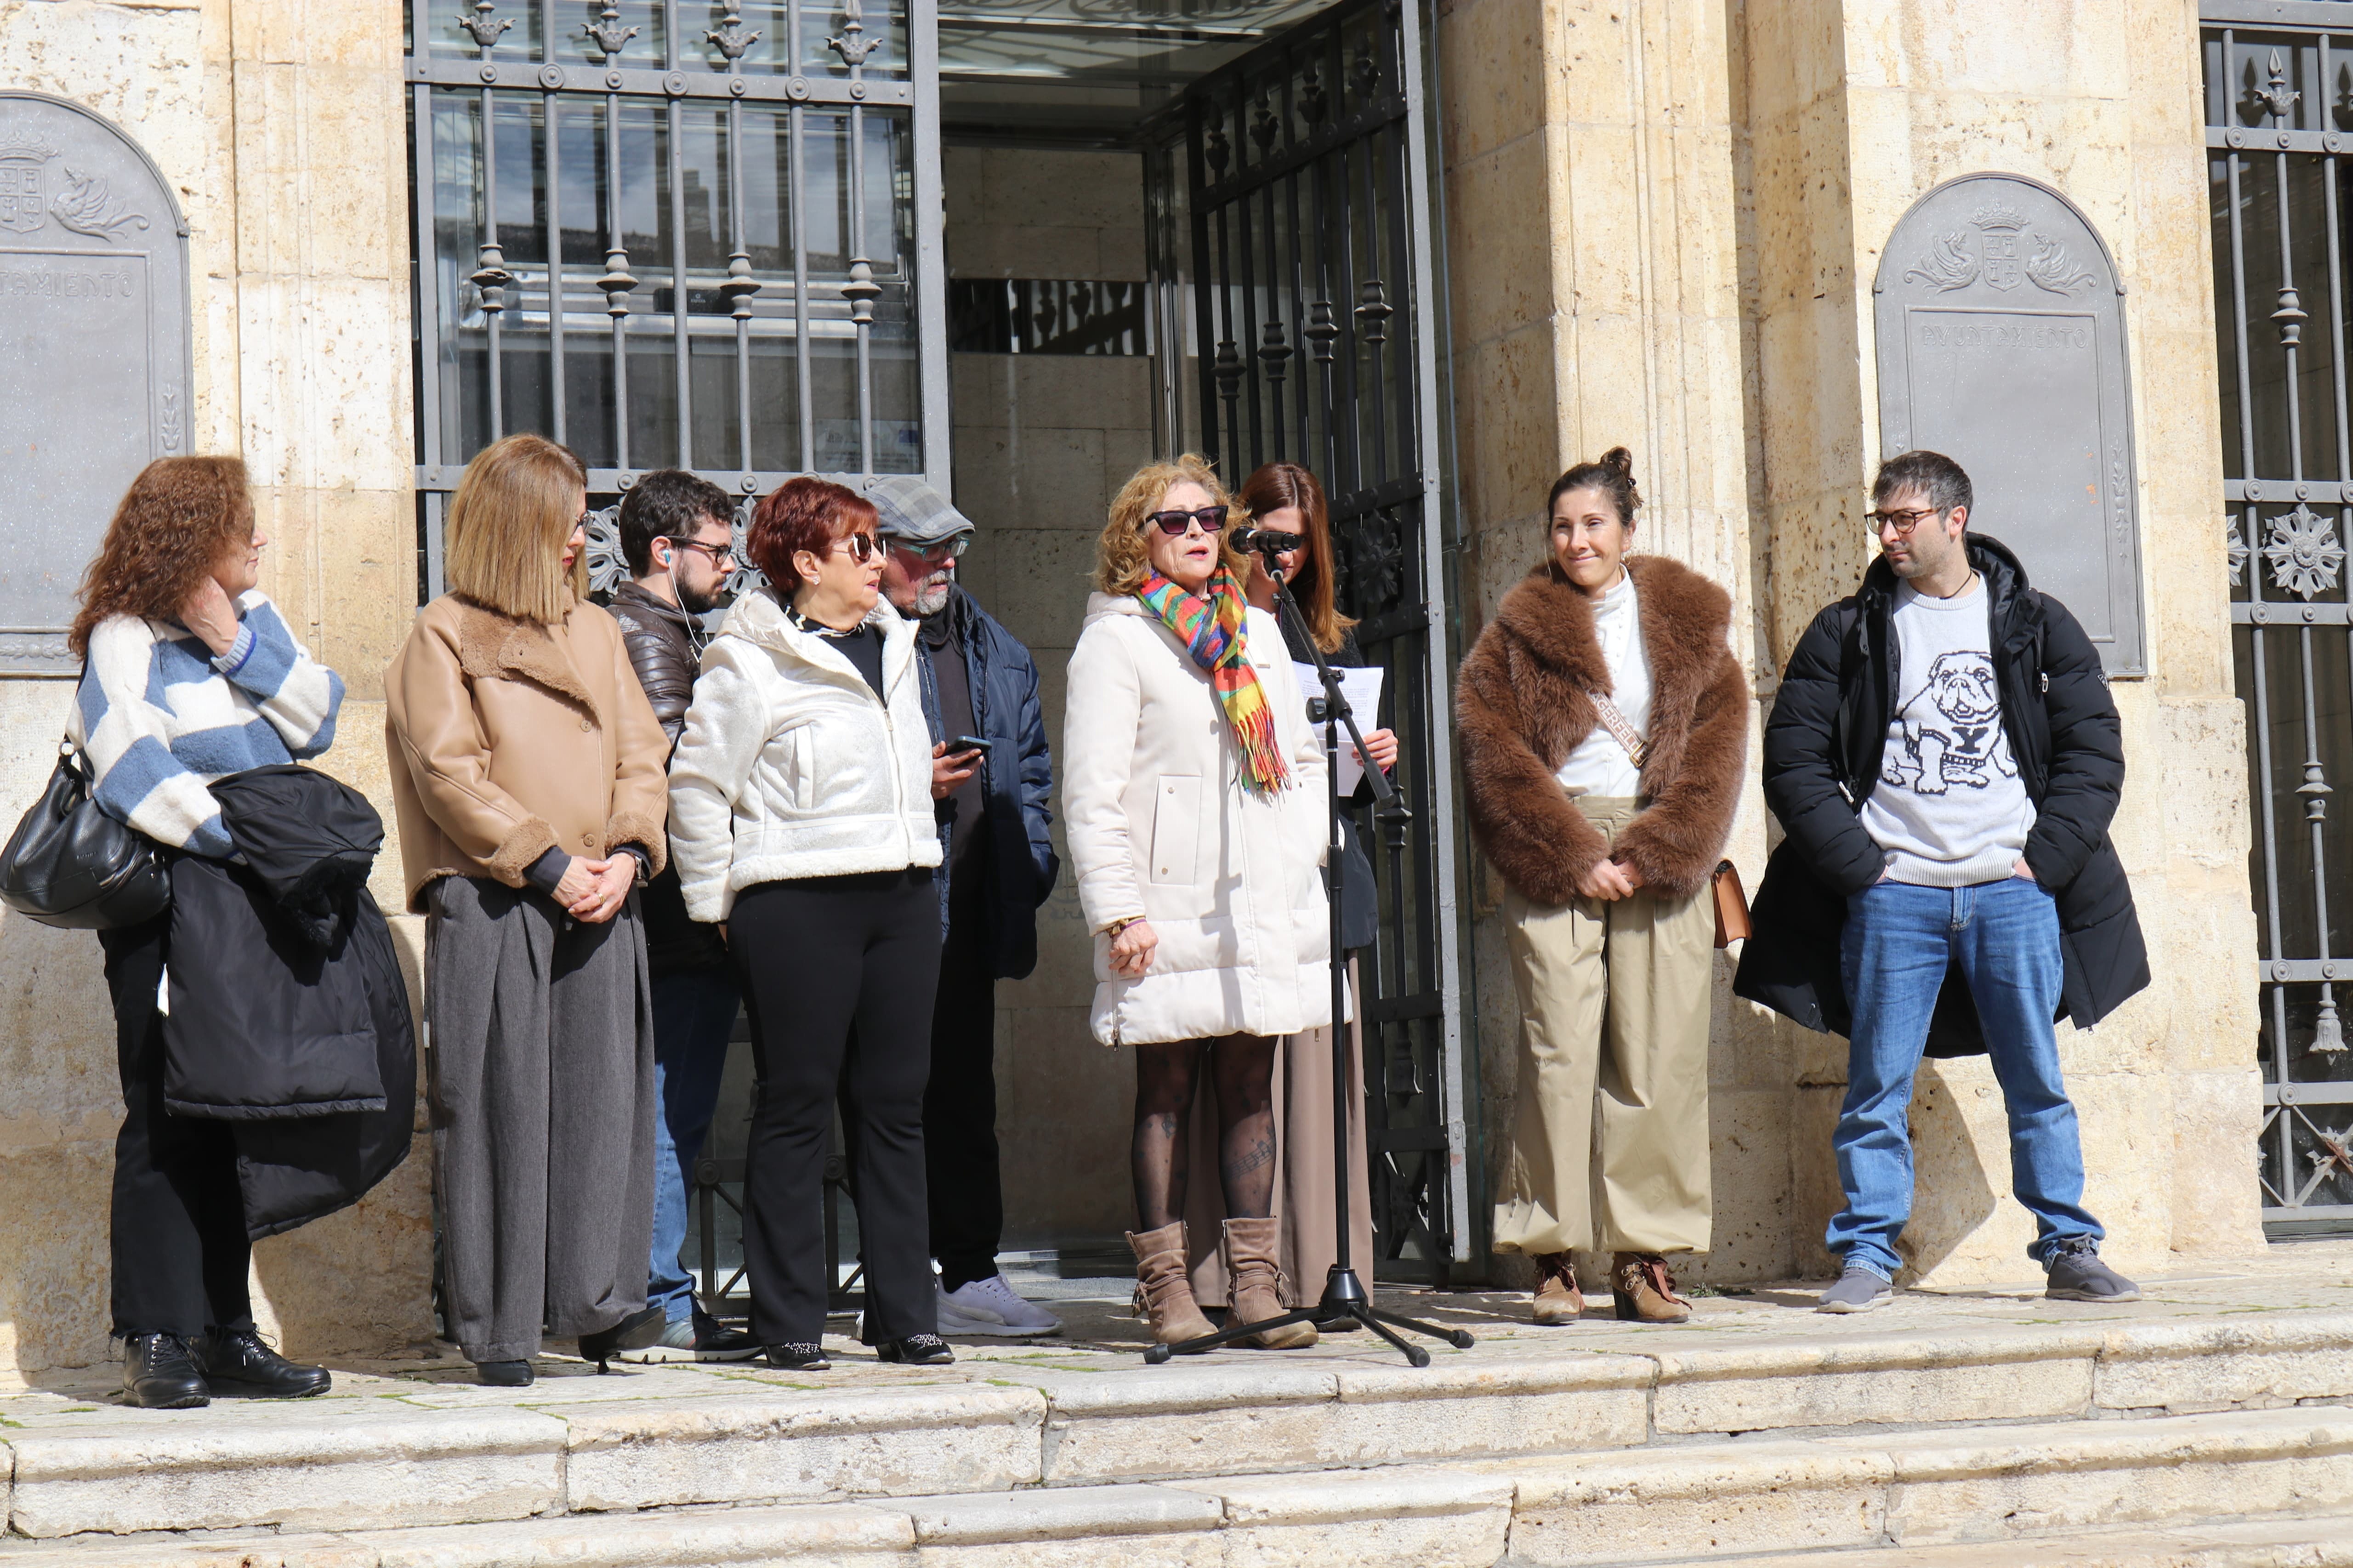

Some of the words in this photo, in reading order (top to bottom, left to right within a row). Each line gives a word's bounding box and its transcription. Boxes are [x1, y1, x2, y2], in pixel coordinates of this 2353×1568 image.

[1922, 324, 2087, 348] AYUNTAMIENTO
[1585, 690, 1641, 752] AGERFELD
[1952, 727, 1989, 754] Y
